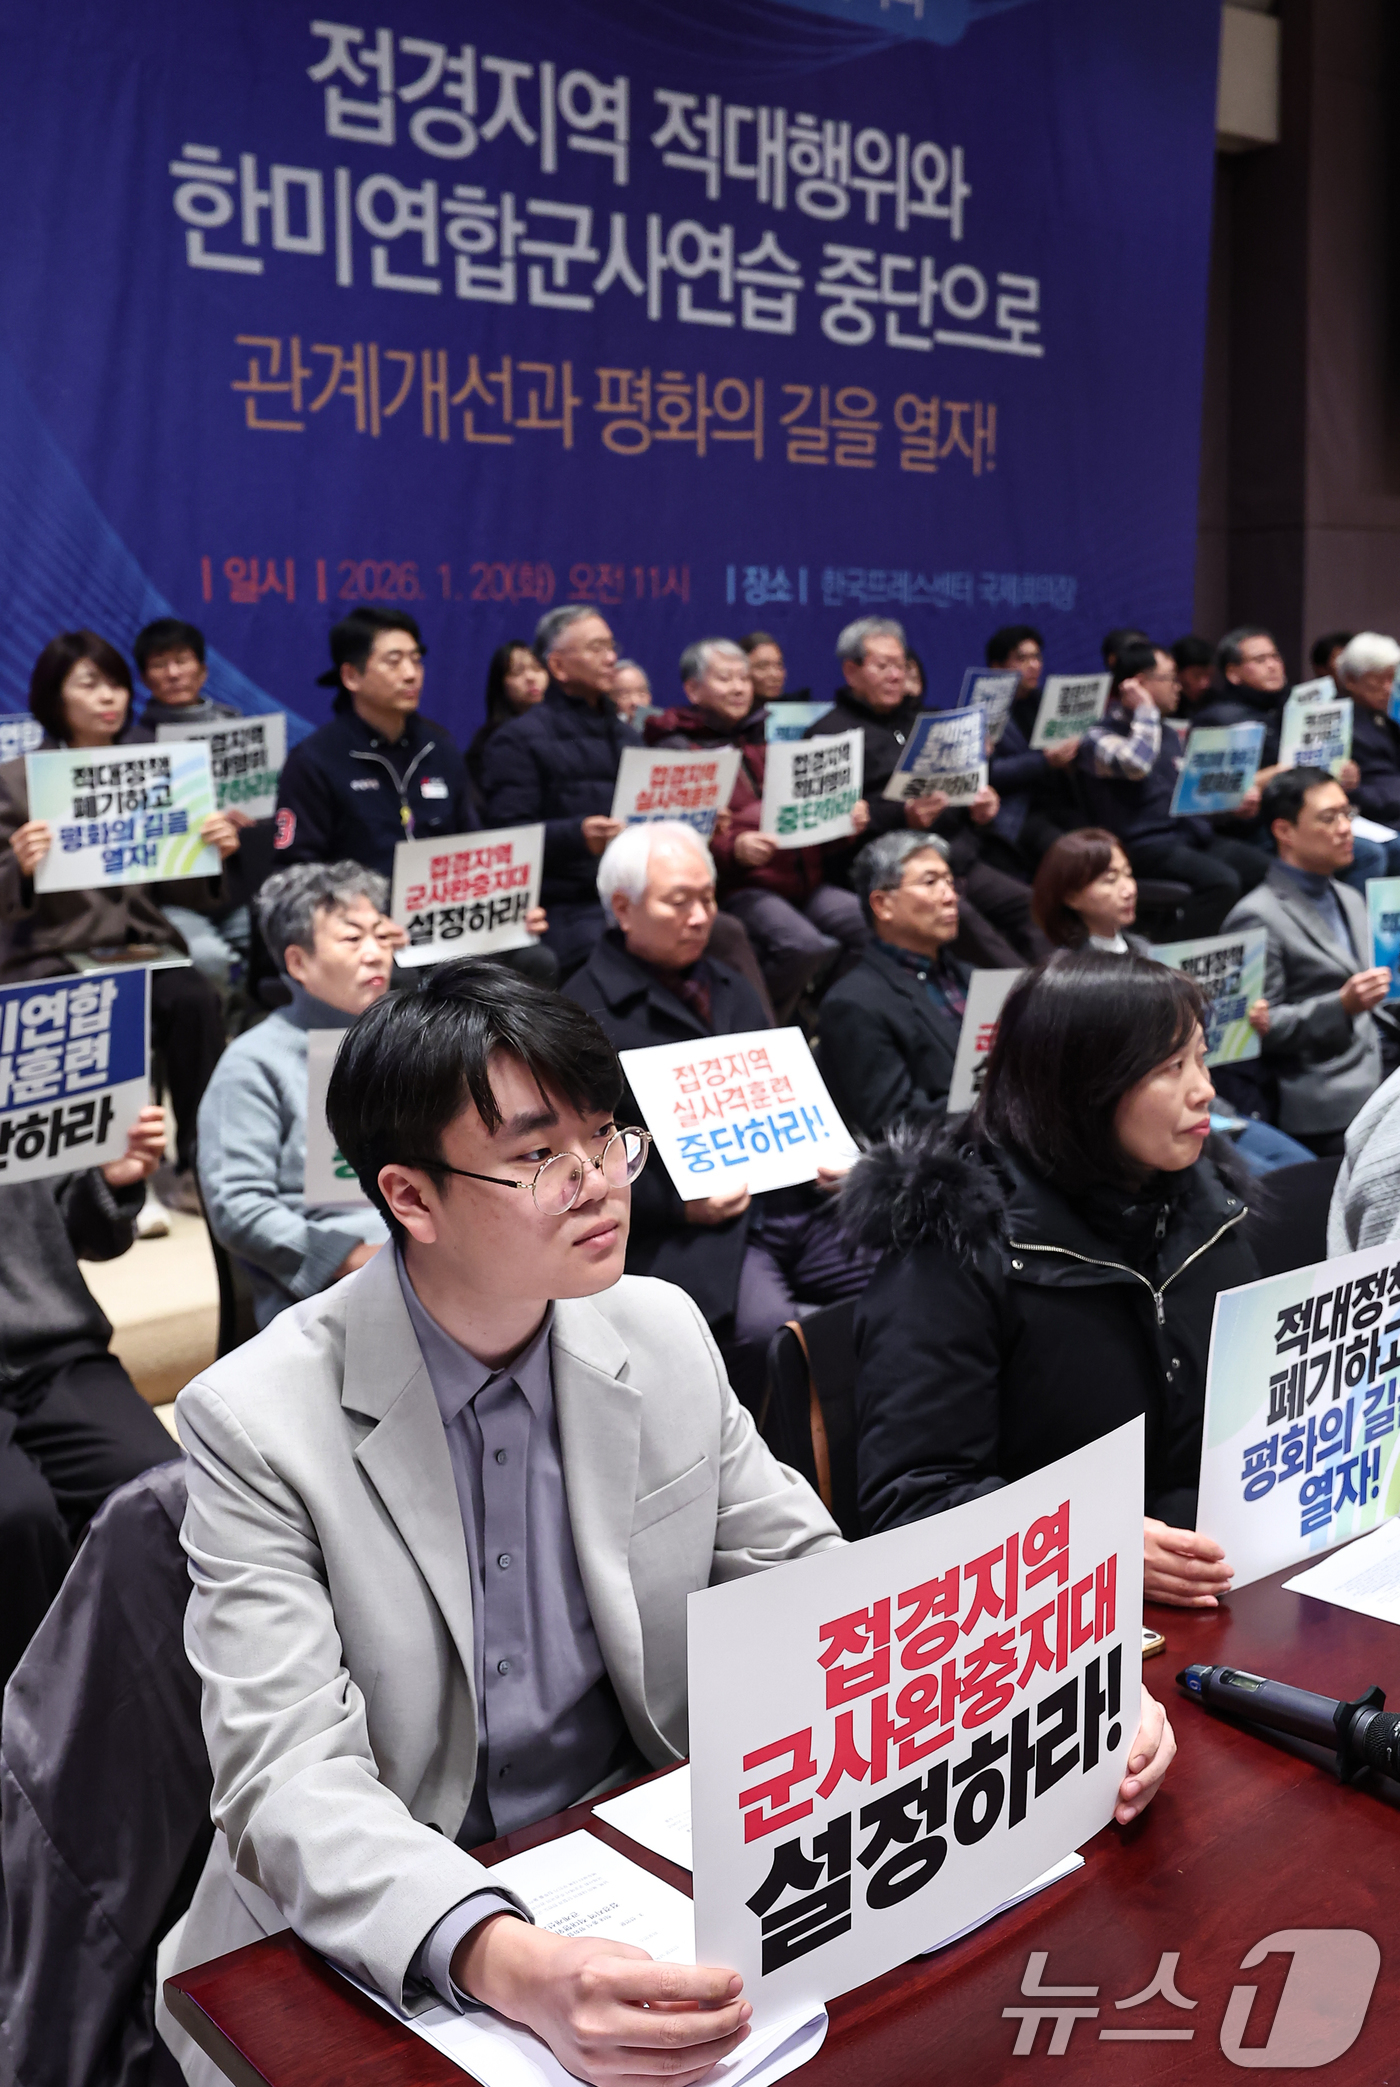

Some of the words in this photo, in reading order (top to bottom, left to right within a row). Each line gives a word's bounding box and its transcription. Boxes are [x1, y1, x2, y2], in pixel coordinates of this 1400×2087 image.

[307, 20, 630, 186] 접경지역
[651, 88, 971, 240] 적대행위와
[168, 142, 804, 335] 한미연합군사연습
[815, 244, 1043, 357] 중단으로
[231, 333, 581, 450] 관계개선과
[594, 366, 764, 461] 평화의
[780, 383, 883, 469] 길을
[894, 392, 997, 477] 열자!
[223, 556, 295, 604] 일시
[567, 561, 625, 605] 오전
[742, 564, 793, 607] 장소
[71, 754, 172, 790] 적대정책
[72, 783, 174, 819] 폐기하고
[58, 819, 135, 853] 평화의
[143, 808, 189, 839] 길을
[102, 842, 158, 875] 열자!
[430, 842, 513, 881] 접경지역
[408, 890, 530, 946] 설정하라!
[671, 1046, 774, 1095] 접경지역
[672, 1075, 797, 1129] 실사격훈련
[676, 1104, 831, 1174] 중단하라!
[1240, 1395, 1355, 1503] 평화의
[1362, 1375, 1400, 1445] 길
[1299, 1444, 1382, 1538] 열자!
[816, 1498, 1071, 1710] 접경지역
[738, 1552, 1118, 1845] 군사완충지대
[744, 1643, 1123, 1978] 설정하라!
